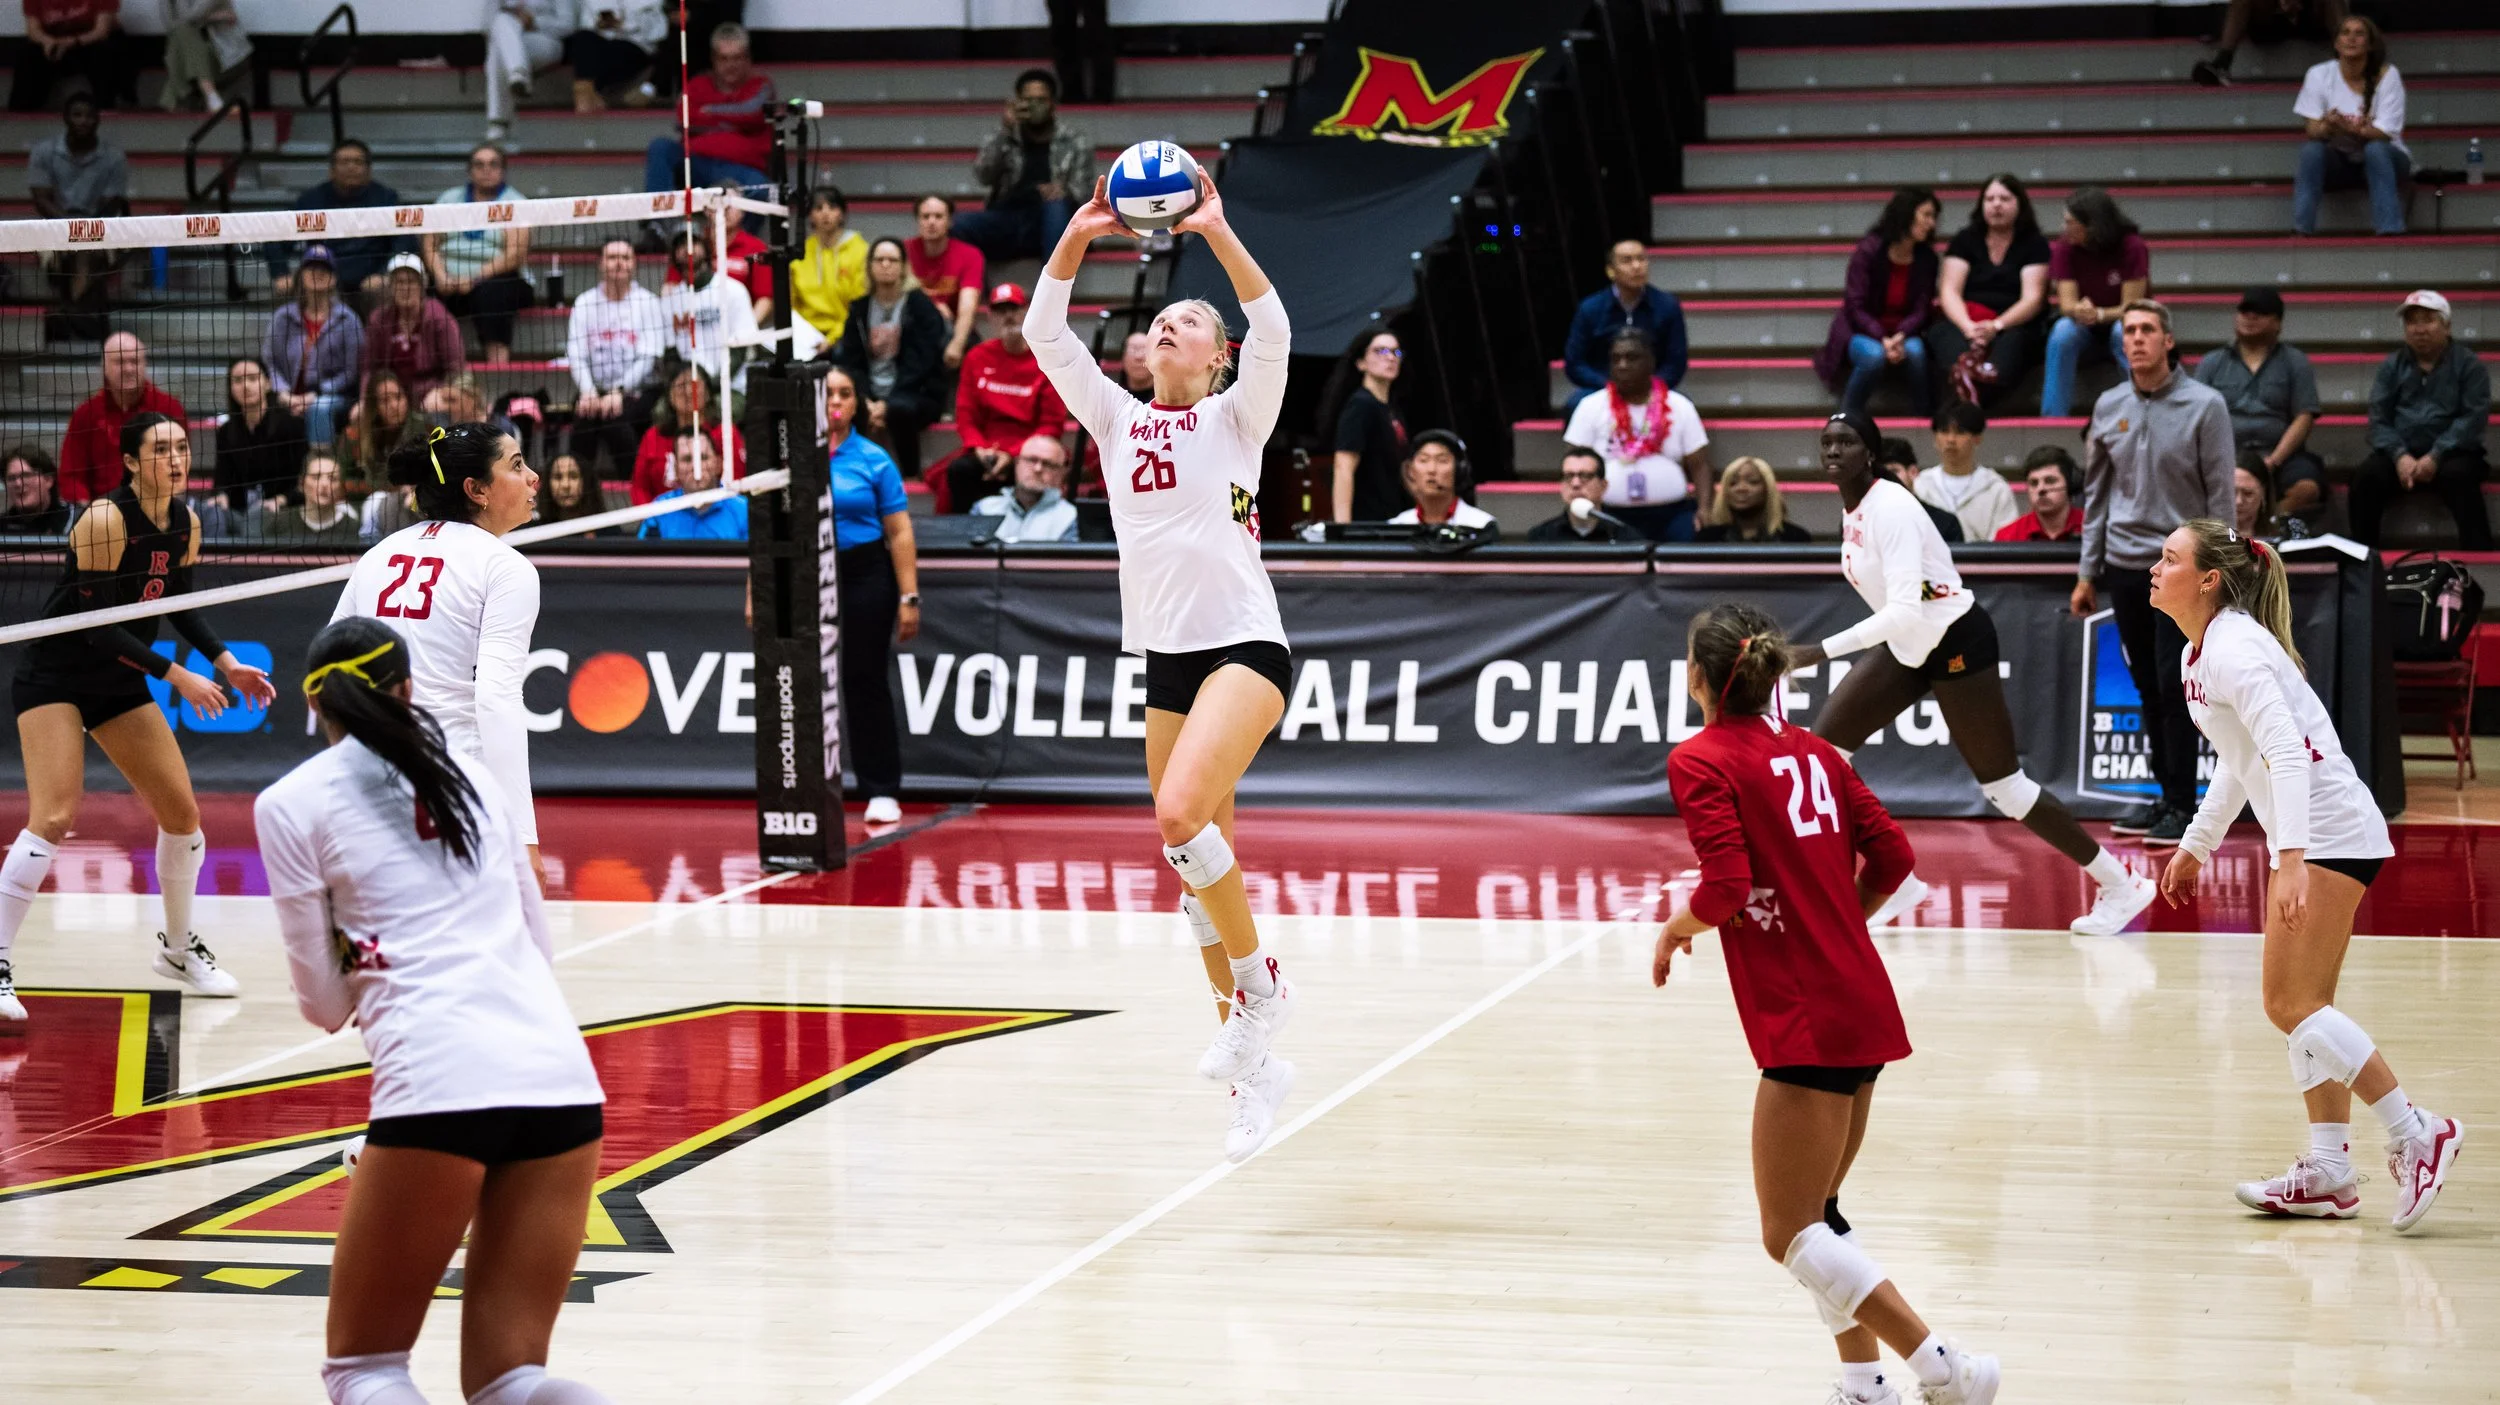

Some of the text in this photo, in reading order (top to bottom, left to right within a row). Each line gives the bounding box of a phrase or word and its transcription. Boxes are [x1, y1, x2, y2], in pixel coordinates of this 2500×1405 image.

[1314, 46, 1548, 136] M
[68, 220, 105, 238] MARYLAND
[186, 216, 221, 234] MARYLAND
[1131, 442, 1177, 493] 26
[420, 520, 447, 537] M
[148, 550, 170, 576] R
[376, 554, 444, 620] 23
[817, 483, 842, 780] TERRAPINS
[776, 665, 796, 720] sports
[897, 652, 1440, 743] VOLLEALL
[1769, 754, 1840, 837] 24
